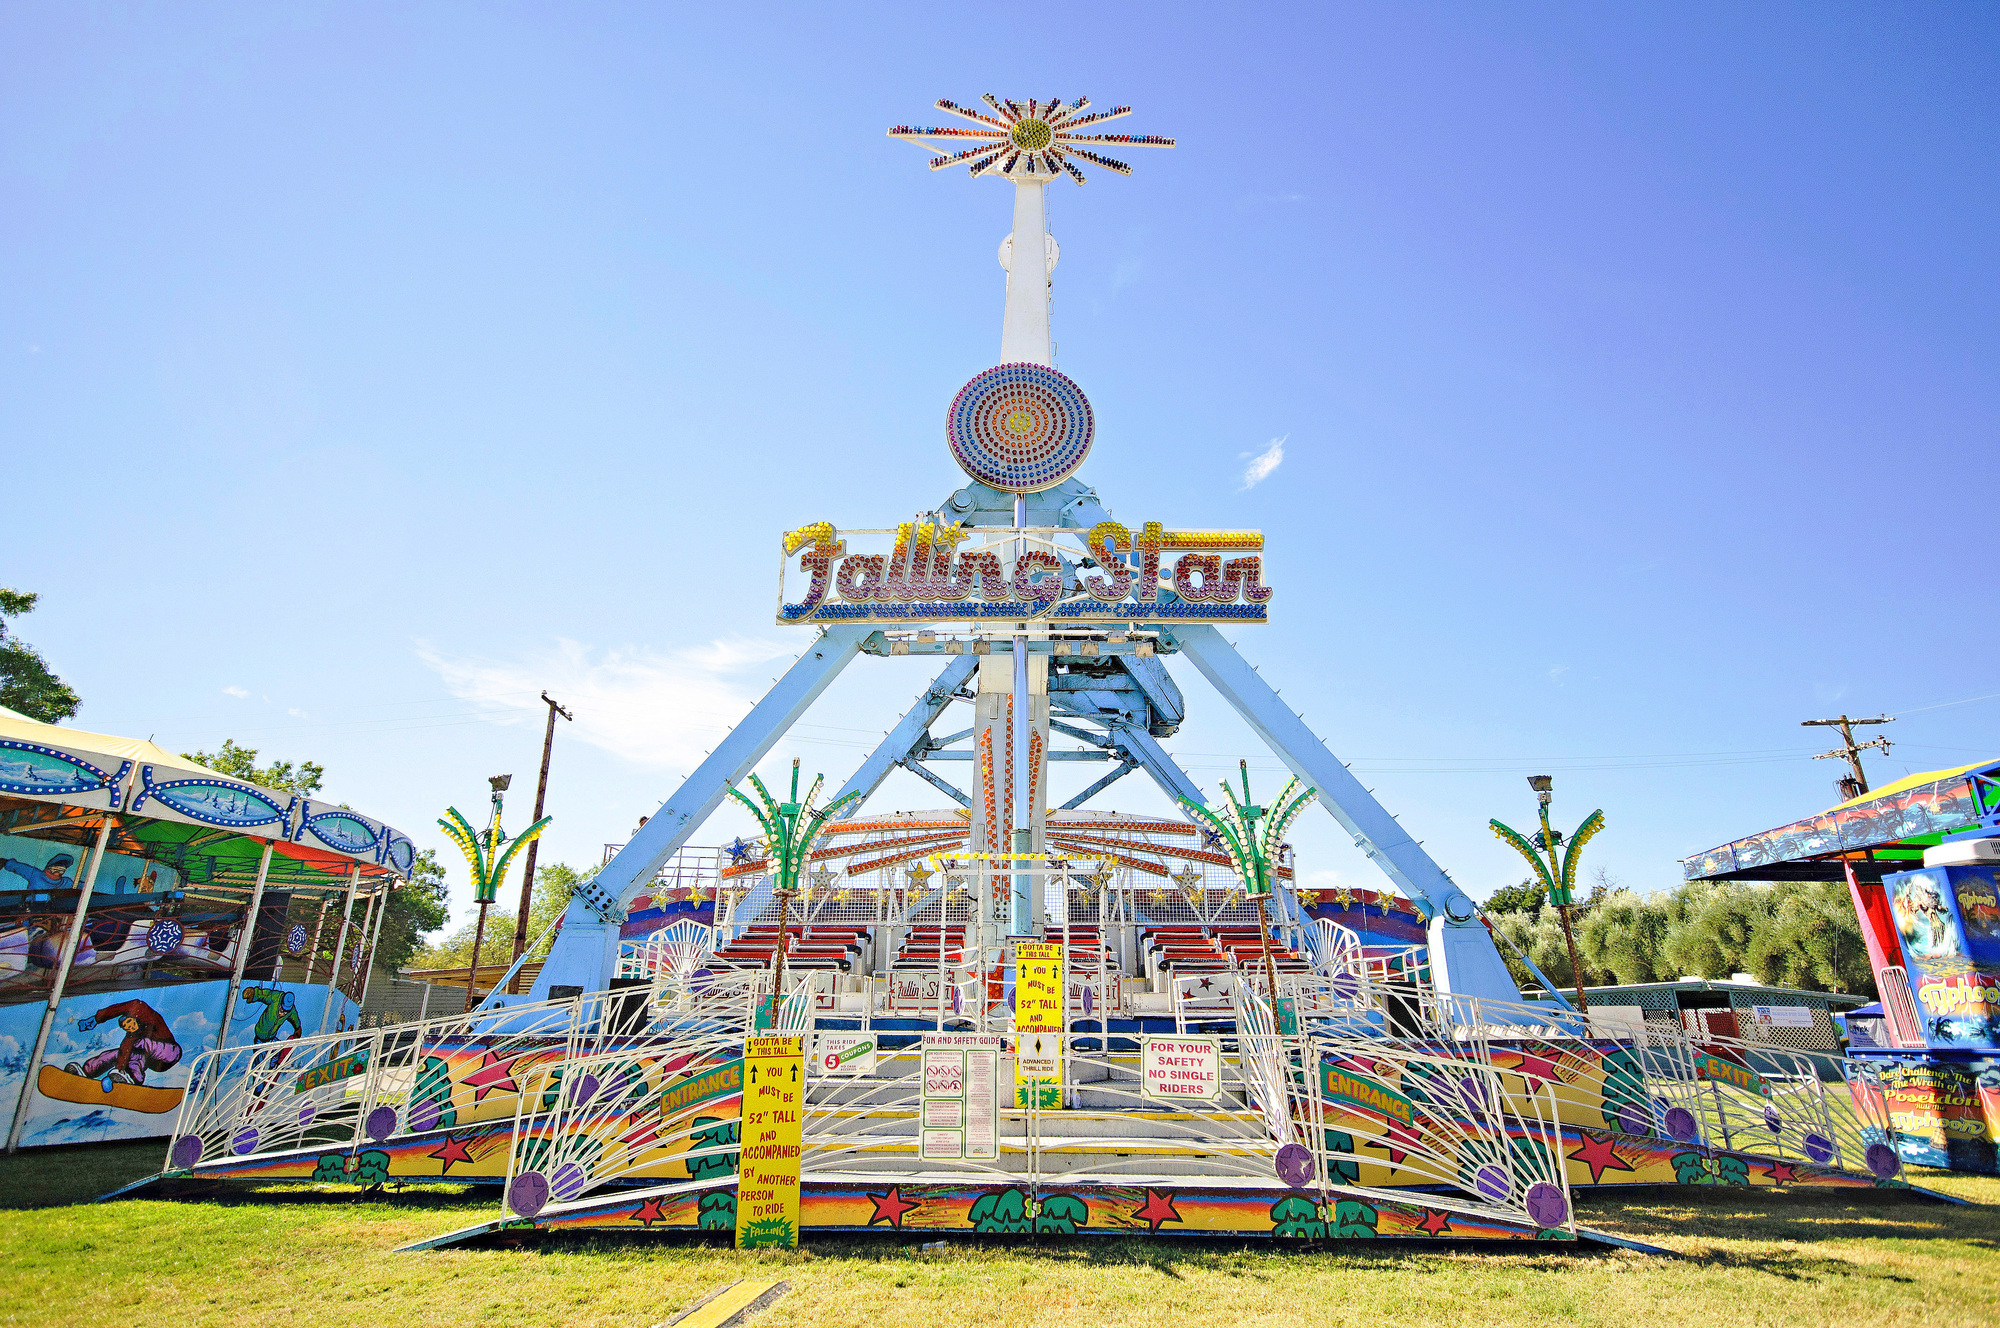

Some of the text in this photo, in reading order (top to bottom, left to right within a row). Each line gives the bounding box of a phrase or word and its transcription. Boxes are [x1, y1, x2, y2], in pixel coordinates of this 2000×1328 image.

[778, 521, 1273, 620] Falling Star
[1958, 891, 1996, 910] Typhoon
[1033, 966, 1046, 974] YOU
[1028, 980, 1055, 994] MUST BE
[1918, 977, 2000, 1016] Typhoo
[1039, 1000, 1057, 1009] TALL
[1030, 1014, 1043, 1023] AND
[753, 1037, 792, 1046] GOTTA BE
[938, 1037, 952, 1045] AND
[953, 1037, 977, 1045] SAFETY
[979, 1037, 999, 1045] GUIDE
[757, 1047, 771, 1055] THIS
[827, 1043, 870, 1068] 5 COUPONS
[1151, 1043, 1211, 1054] FOR YOUR
[1158, 1056, 1204, 1067] SAFETY
[304, 1056, 353, 1090] EXIT
[766, 1067, 782, 1077] YOU
[1149, 1069, 1214, 1081] NO SINGLE
[1707, 1058, 1753, 1088] EXIT
[1879, 1067, 1972, 1084] Dare Challenge The
[660, 1065, 740, 1116] ENTRANCE
[1160, 1083, 1204, 1094] RIDERS
[1892, 1077, 1958, 1093] The Wrath of
[758, 1085, 793, 1102] MUST BE
[1327, 1070, 1410, 1123] ENTRANCE
[1884, 1089, 1981, 1107] Poseidon
[749, 1110, 796, 1124] 52" TALL
[1889, 1111, 1987, 1135] Typhoon
[760, 1130, 777, 1143] AND
[742, 1144, 800, 1159] ACCOMPANIED
[743, 1166, 796, 1186] BY ANOTHER
[740, 1190, 774, 1201] PERSON
[753, 1203, 784, 1216] TO RIDE
[750, 1225, 785, 1238] FALLING
